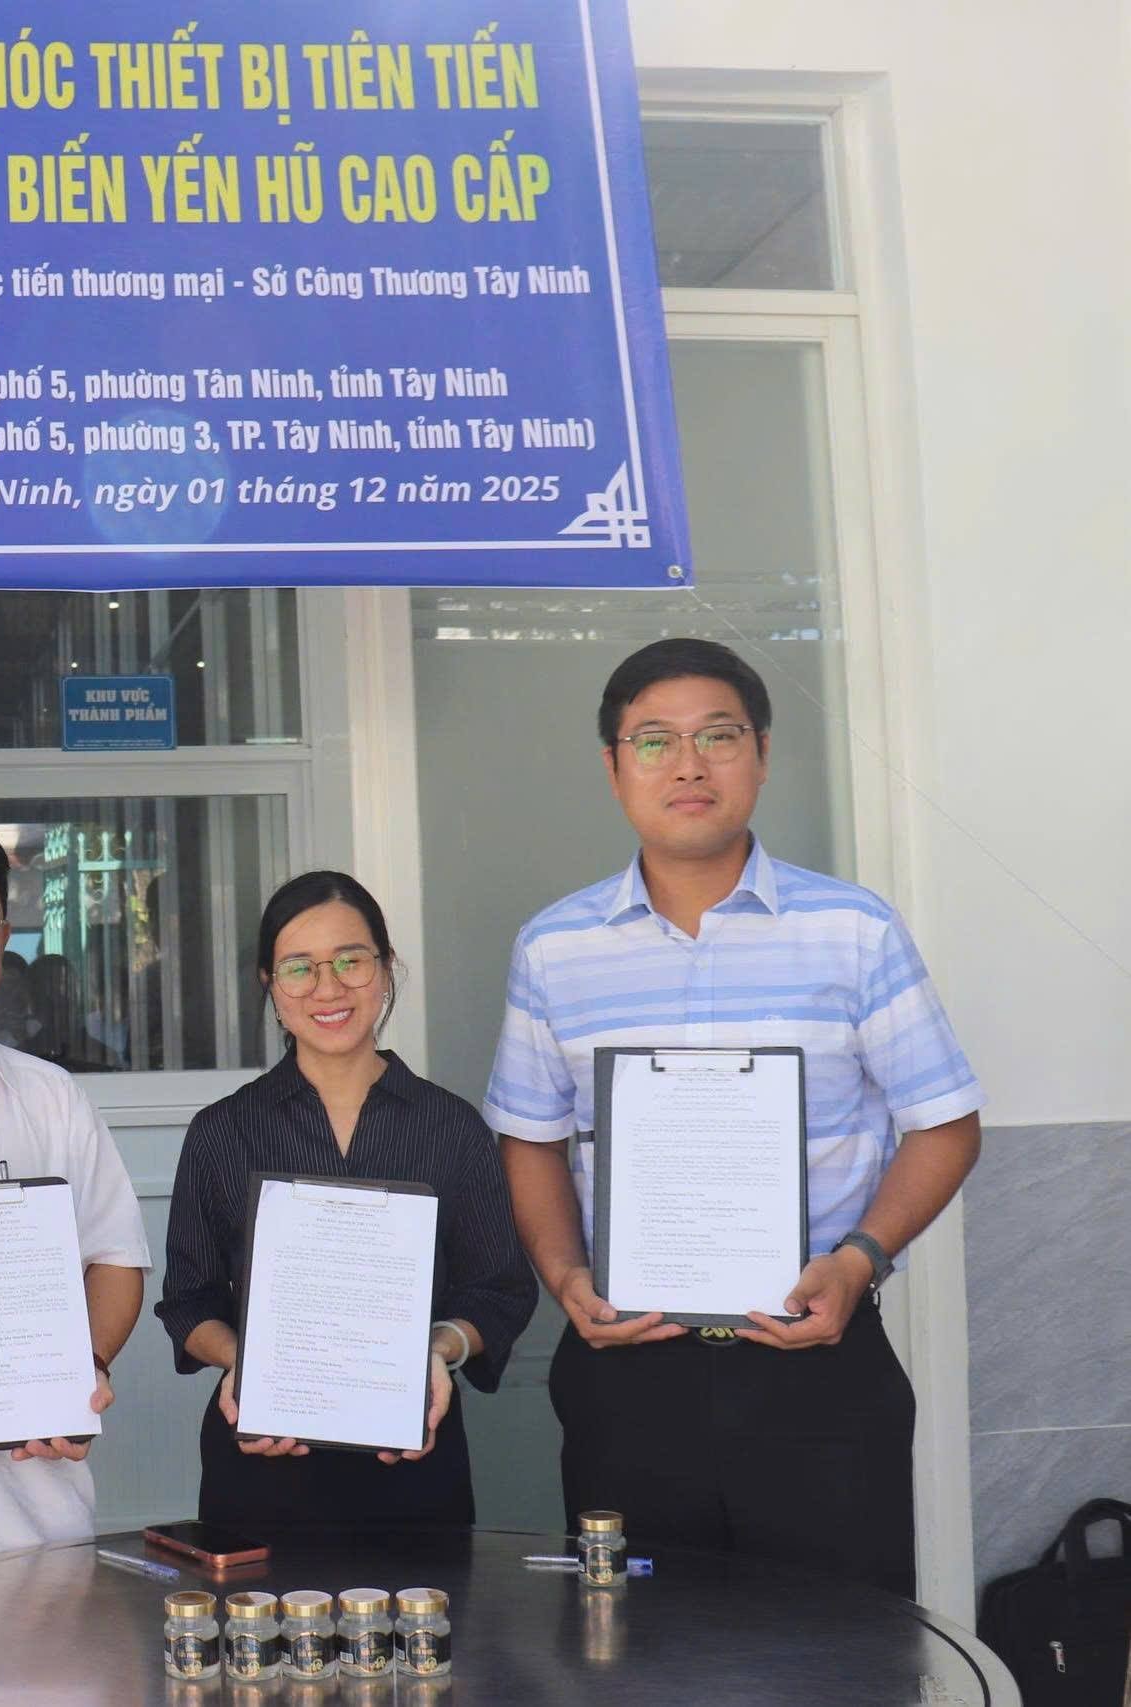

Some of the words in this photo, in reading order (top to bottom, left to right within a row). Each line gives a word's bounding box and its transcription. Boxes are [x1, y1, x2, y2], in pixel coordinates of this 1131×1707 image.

[89, 21, 224, 110] THIẾT
[239, 43, 291, 125] BỊ
[302, 29, 415, 110] TIÊN
[424, 20, 539, 110] TIẾN
[7, 132, 127, 223] BIẾN
[140, 133, 241, 223] YẾN
[255, 141, 324, 224] HŨ
[338, 154, 437, 224] CAO
[451, 129, 551, 223] CẤP
[11, 262, 64, 297] tiến
[71, 267, 165, 301] thương
[173, 267, 225, 303] mại
[252, 263, 288, 297] Sở
[295, 266, 364, 300] Công
[369, 266, 468, 299] Thương
[473, 265, 520, 299] Tây
[526, 264, 591, 295] Ninh
[50, 369, 76, 403] 5,
[84, 368, 186, 403] phường
[192, 368, 243, 399] Tân
[250, 368, 323, 402] Ninh,
[329, 364, 383, 398] tỉnh
[388, 367, 437, 401] Tây
[444, 367, 509, 397] Ninh
[49, 421, 75, 455] 5,
[83, 419, 186, 455] phường
[193, 420, 220, 454] 3,
[226, 420, 266, 450] TP.
[272, 419, 320, 454] Tây
[328, 419, 401, 453] Ninh,
[407, 415, 461, 449] tỉnh
[466, 417, 514, 453] Tây
[521, 417, 596, 451] Ninh)
[94, 476, 179, 513] ngày
[187, 477, 225, 504] 01
[237, 475, 339, 511] tháng
[349, 476, 387, 503] 12
[397, 474, 471, 503] năm
[481, 475, 560, 502] 2025
[68, 706, 121, 722] THÀNH
[85, 690, 117, 703] KHU
[121, 687, 150, 706] VỰC
